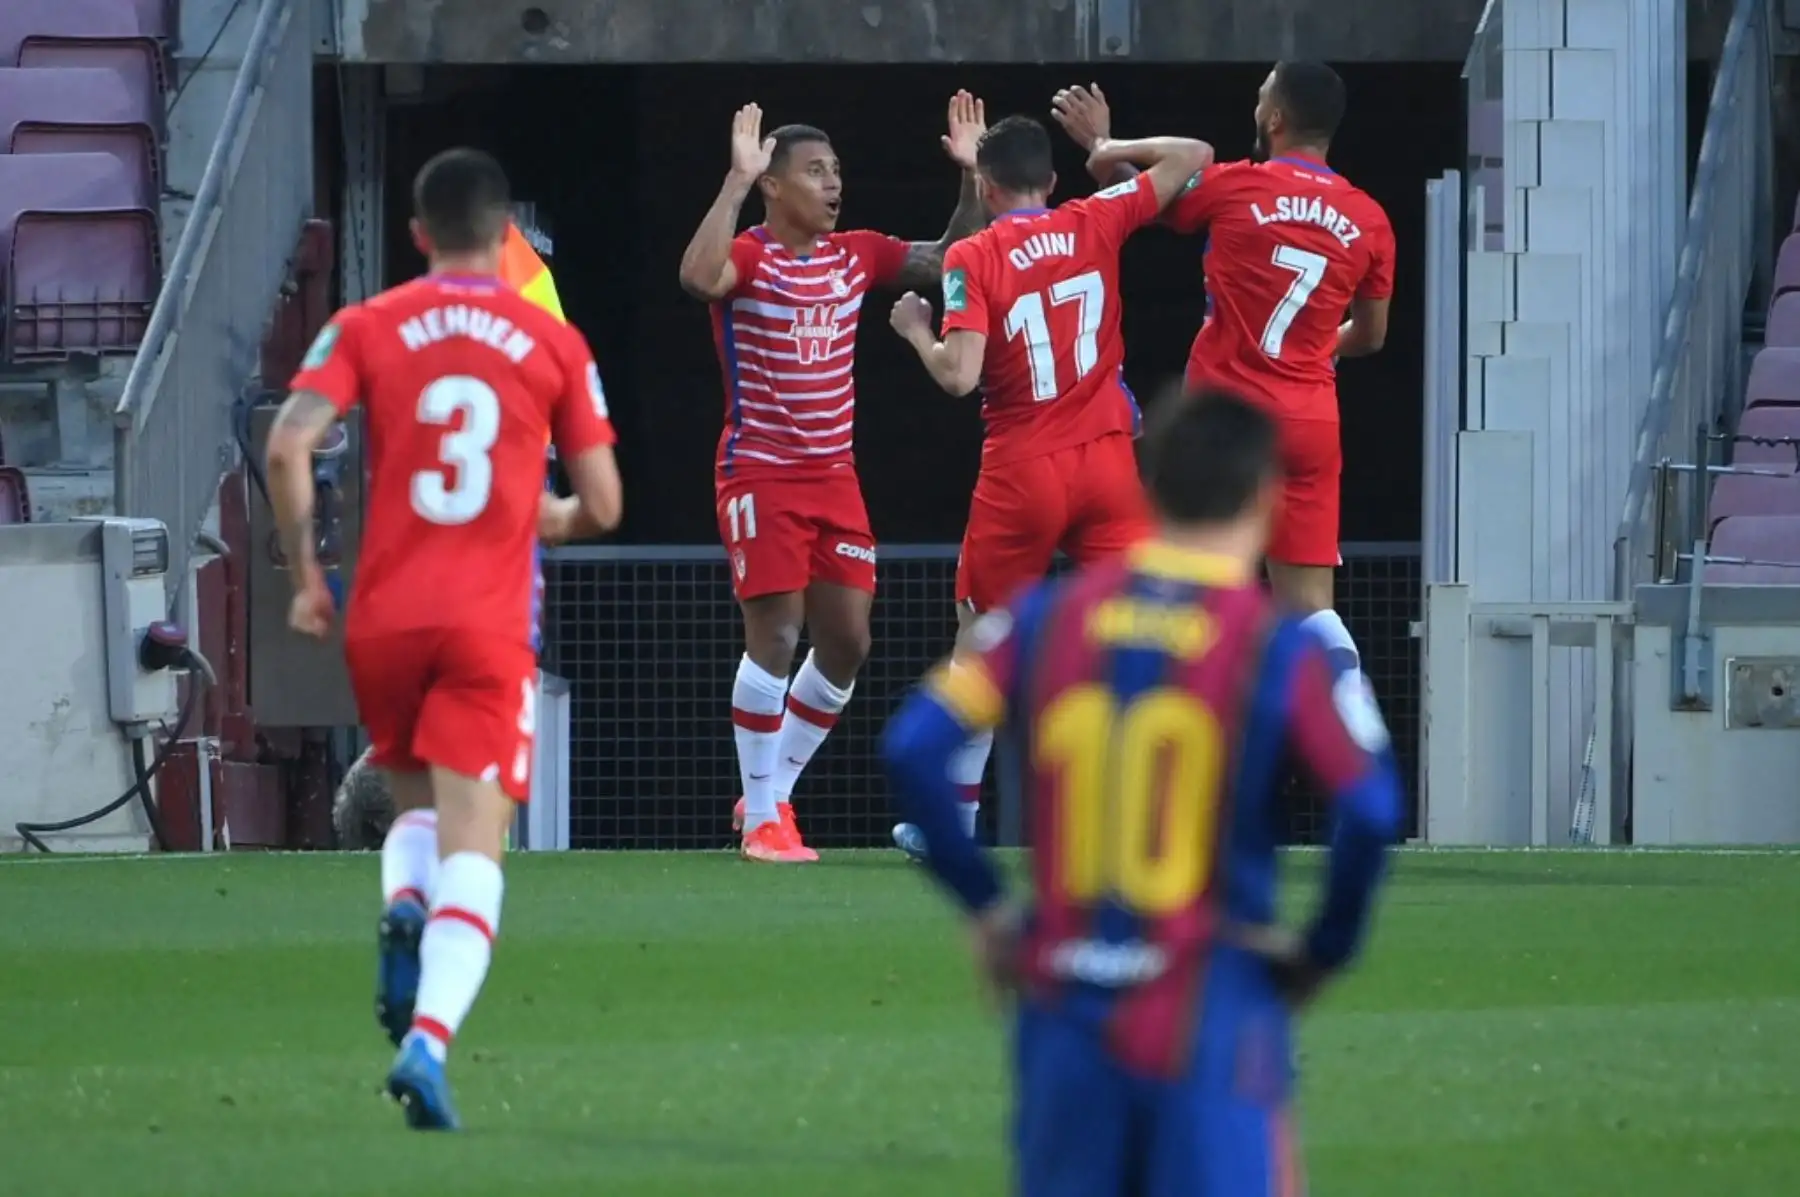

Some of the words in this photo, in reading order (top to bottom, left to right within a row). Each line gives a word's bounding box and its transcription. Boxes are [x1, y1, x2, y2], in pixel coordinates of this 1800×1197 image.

[1008, 232, 1076, 271] QUINI
[1250, 196, 1361, 248] L.SUÁREZ
[1003, 270, 1105, 402] 17
[1260, 244, 1328, 359] 7
[409, 374, 500, 526] 3
[727, 492, 757, 543] 11
[1036, 684, 1224, 917] 10
